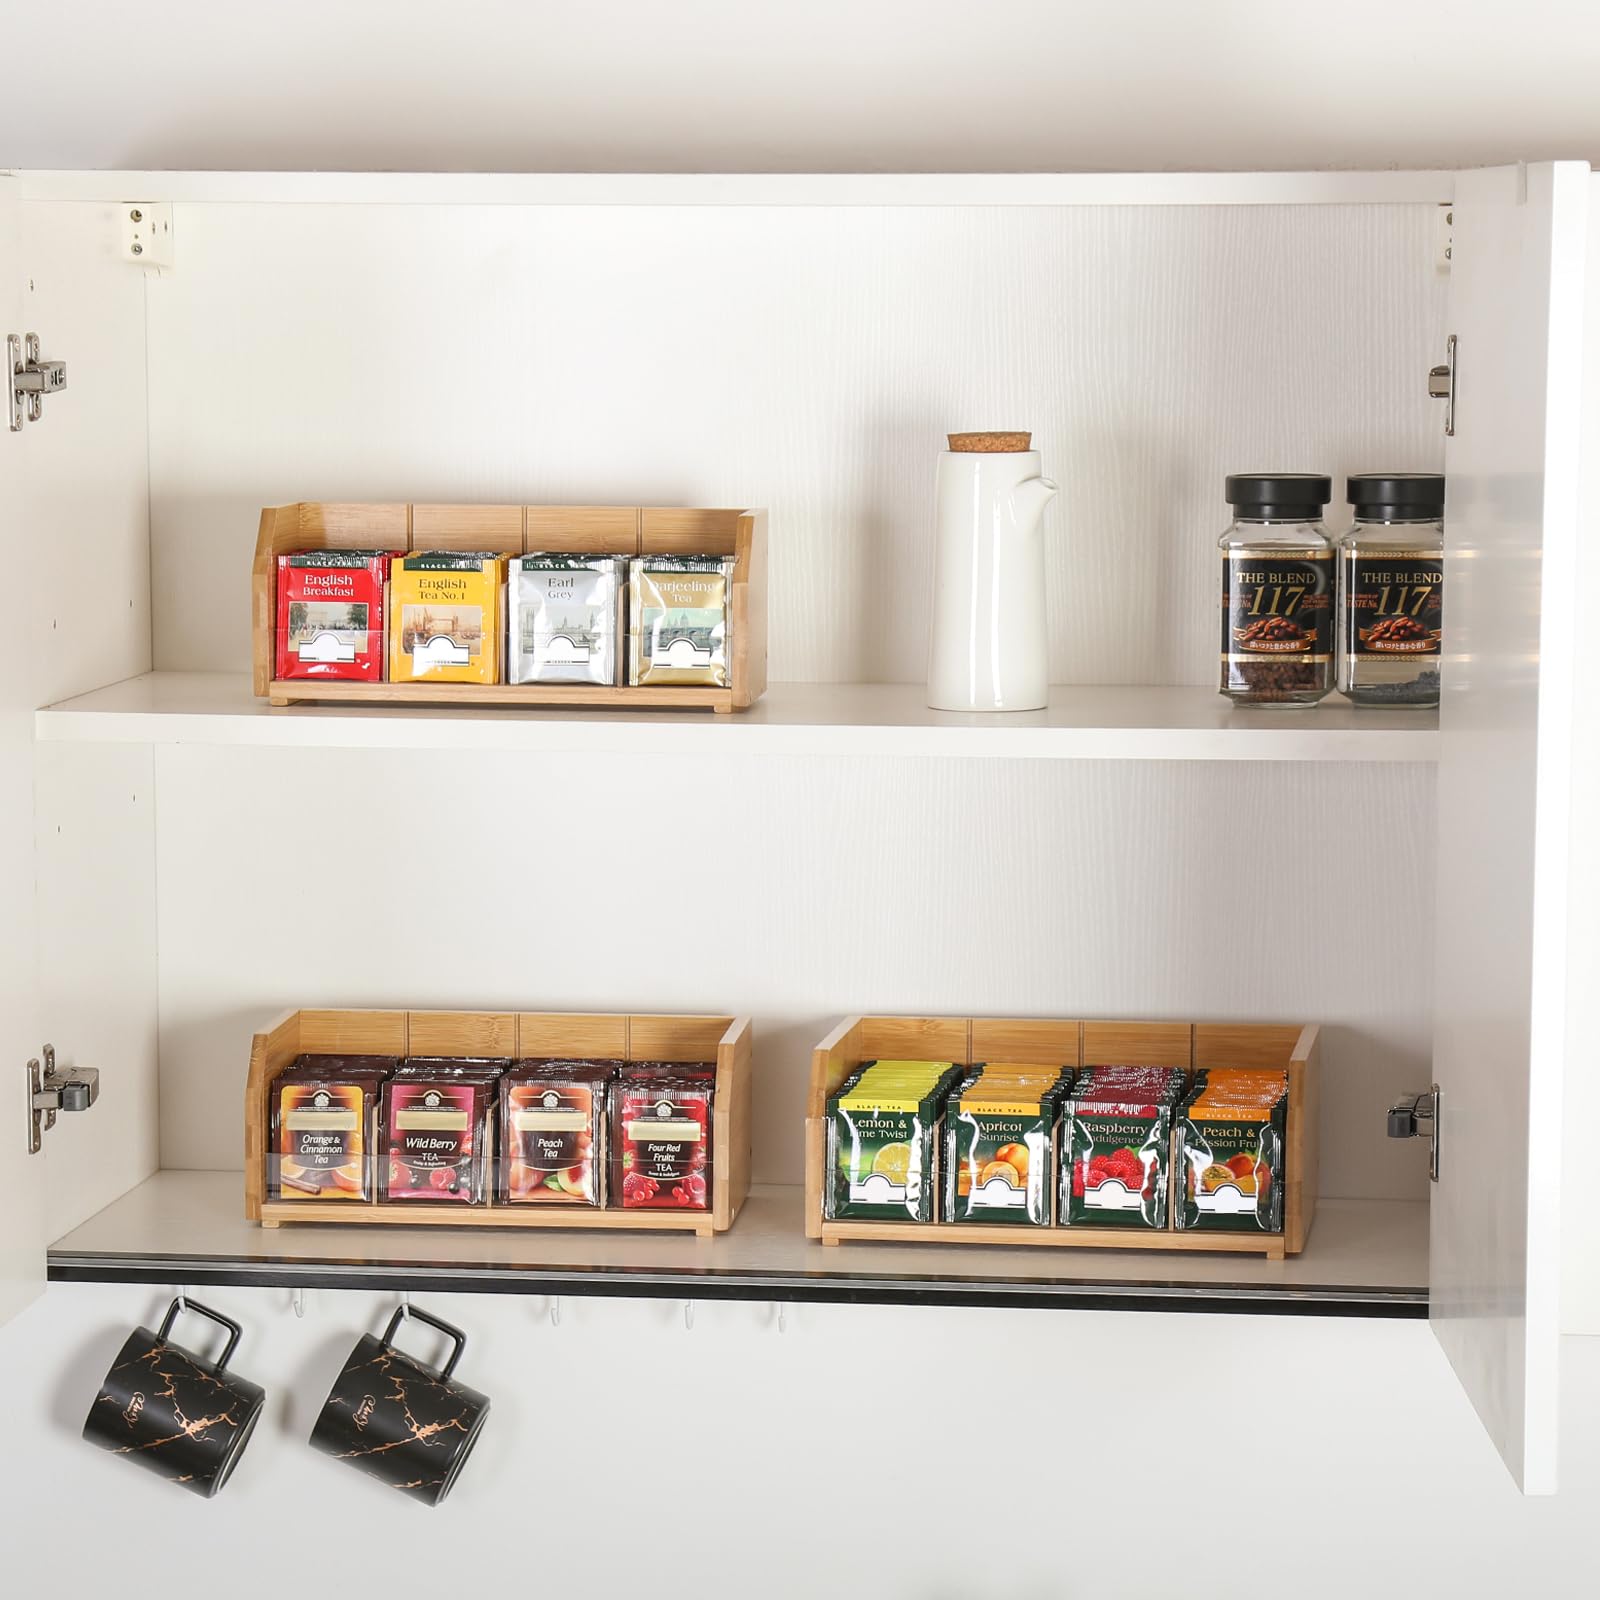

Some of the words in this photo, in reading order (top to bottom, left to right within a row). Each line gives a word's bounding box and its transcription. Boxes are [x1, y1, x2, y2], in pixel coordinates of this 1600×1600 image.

[305, 574, 353, 586] English
[548, 577, 574, 588] Earl
[1236, 572, 1265, 584] THE
[1269, 573, 1316, 584] BLEND
[1362, 572, 1392, 584] THE
[1396, 573, 1443, 584] BLEND
[419, 578, 467, 591] English
[303, 586, 354, 596] Breakfast
[419, 591, 438, 600] Tea
[548, 591, 574, 600] Grey
[672, 593, 692, 603] Tea
[1247, 585, 1306, 617] 117
[1373, 585, 1433, 616] 117
[898, 1119, 907, 1129] &
[978, 1121, 1022, 1133] Apricot
[878, 1130, 908, 1139] Twist
[979, 1133, 1020, 1142] Sunrise
[1203, 1127, 1242, 1137] Peach
[1246, 1128, 1256, 1138] &
[302, 1134, 333, 1144] Orange
[334, 1136, 341, 1144] &
[406, 1137, 429, 1149] Wild
[429, 1139, 457, 1151] Berry
[538, 1138, 563, 1148] Peach
[1195, 1138, 1236, 1148] Passion
[300, 1144, 343, 1154] Cinnamon
[648, 1143, 666, 1152] Four
[666, 1143, 681, 1152] Red
[421, 1152, 439, 1161] TEA
[543, 1148, 558, 1158] Tea
[653, 1152, 675, 1162] Fruits
[314, 1155, 329, 1164] Tea
[655, 1163, 673, 1172] TEA
